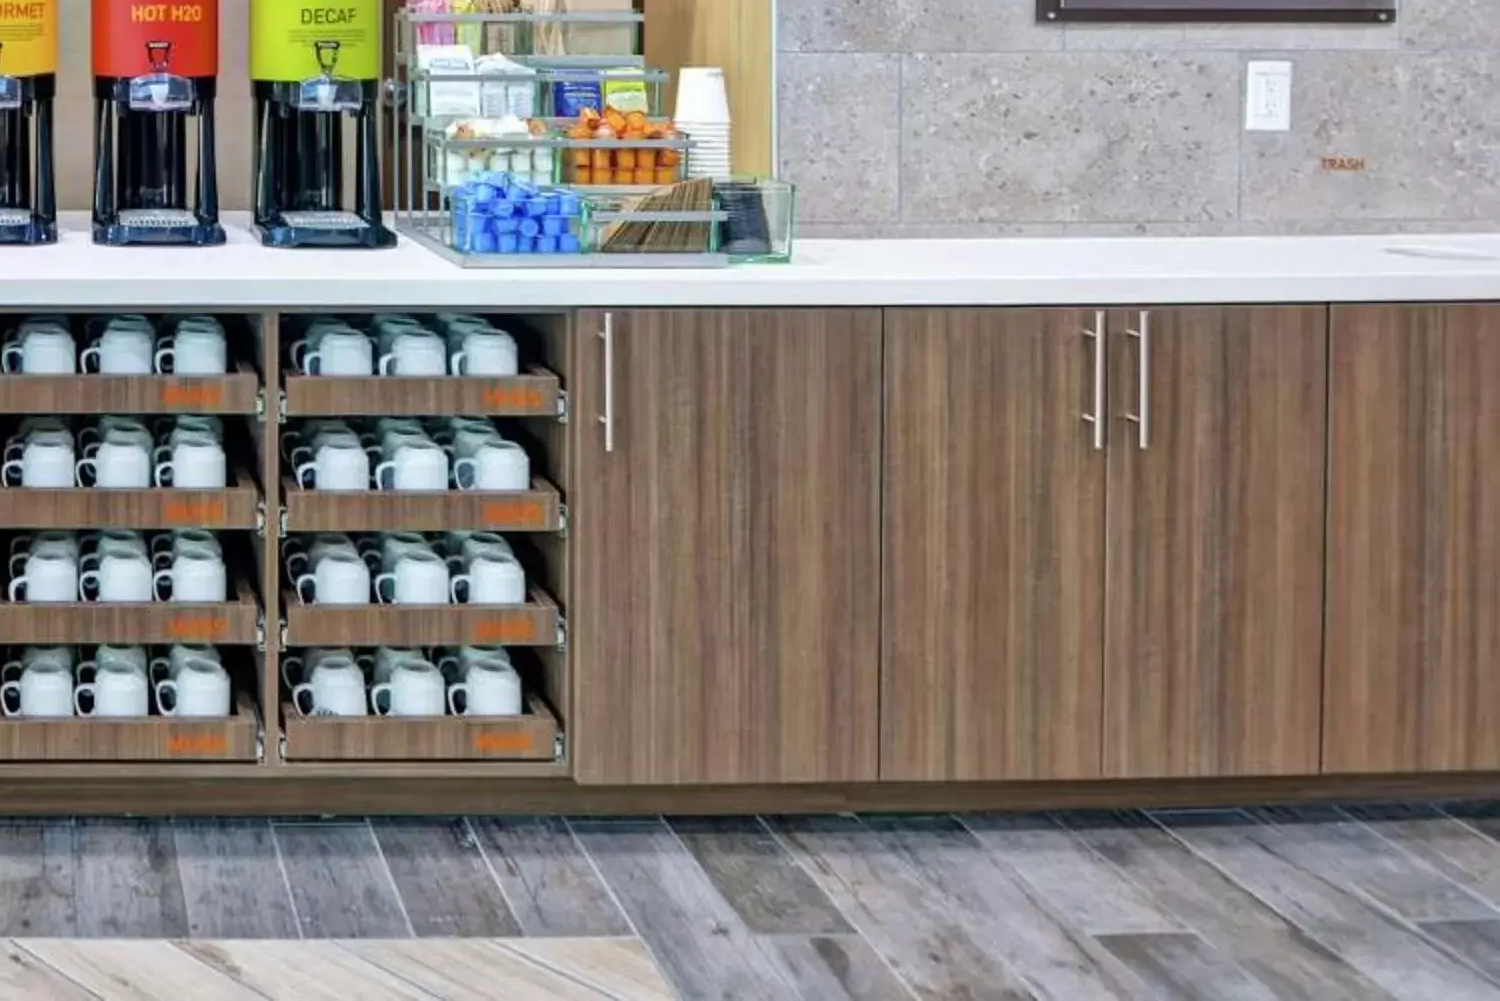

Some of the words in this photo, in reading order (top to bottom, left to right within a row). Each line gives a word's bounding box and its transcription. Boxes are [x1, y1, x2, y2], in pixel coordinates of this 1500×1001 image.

[131, 4, 168, 22] HOT
[300, 7, 357, 24] DECAF
[1321, 157, 1365, 170] TRASH
